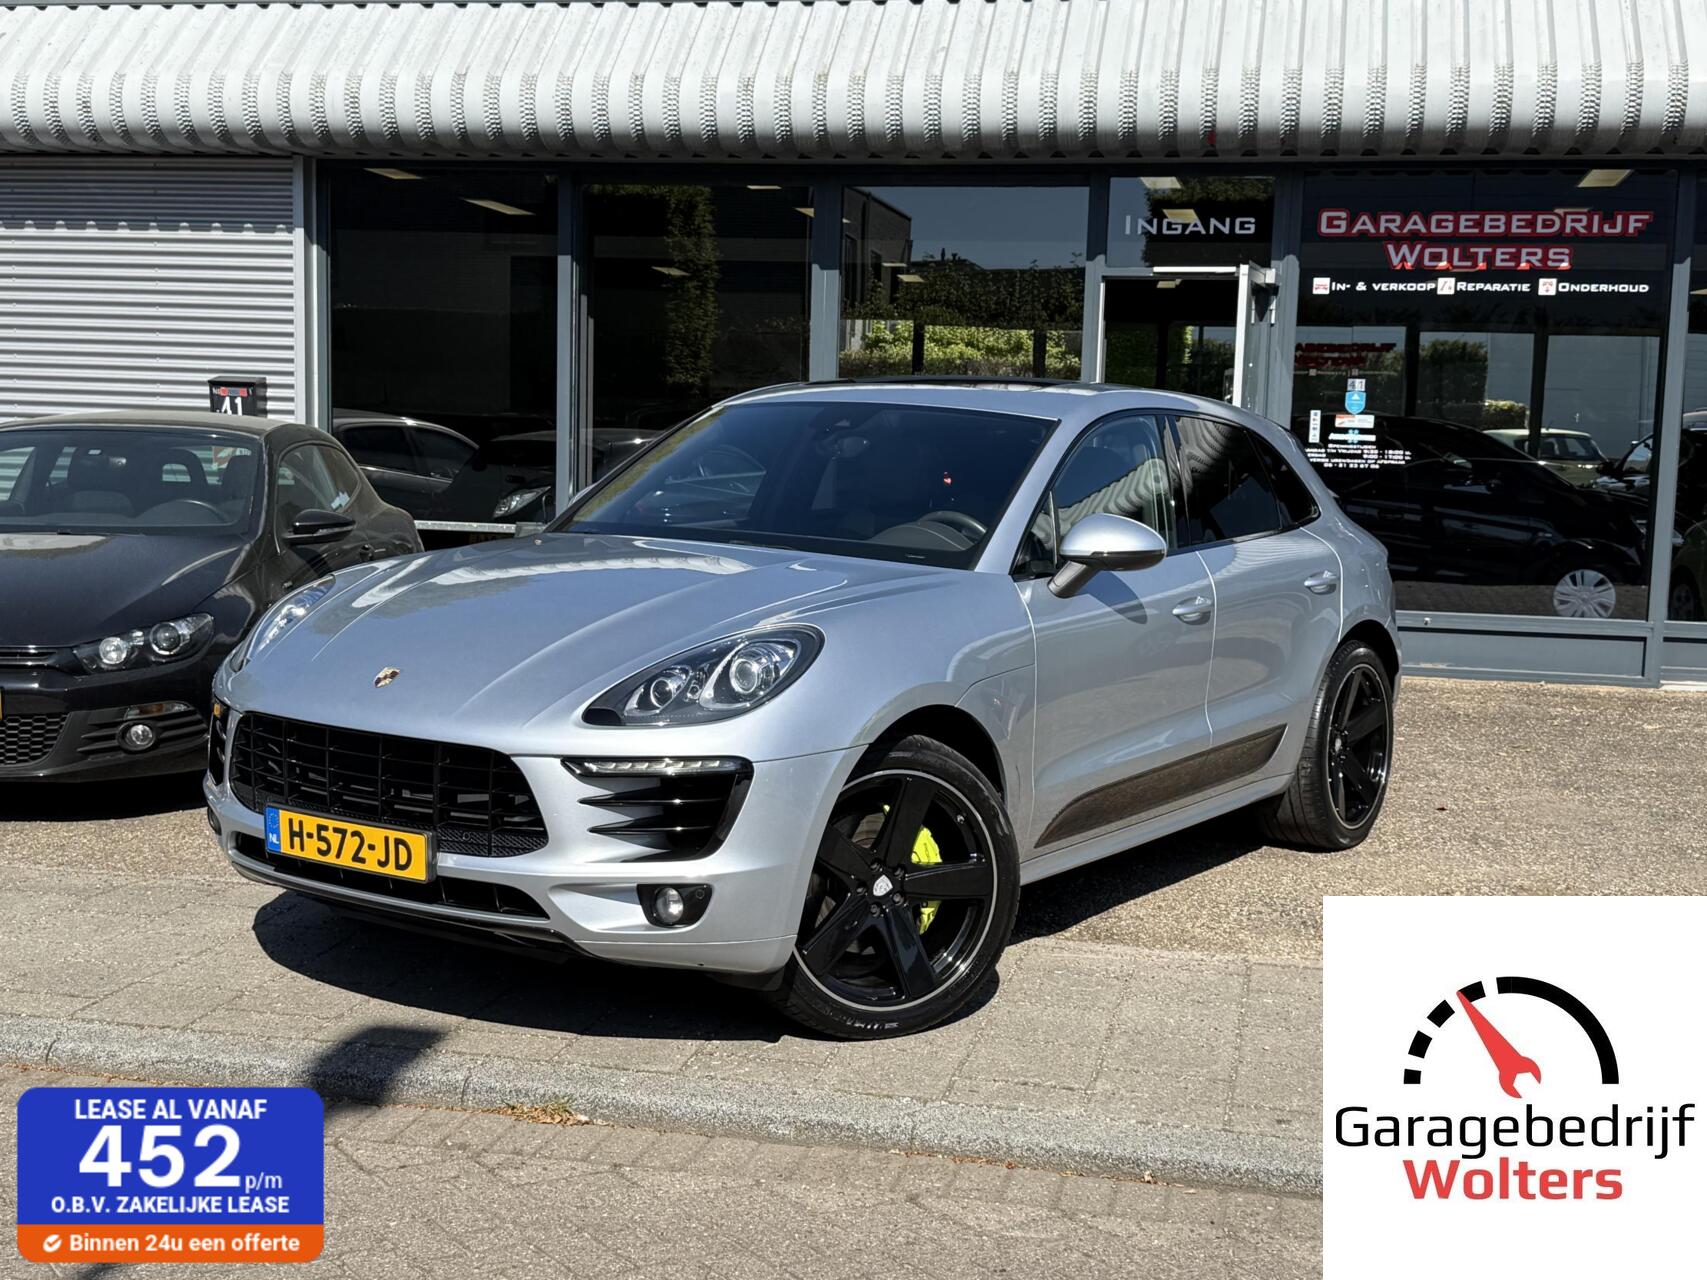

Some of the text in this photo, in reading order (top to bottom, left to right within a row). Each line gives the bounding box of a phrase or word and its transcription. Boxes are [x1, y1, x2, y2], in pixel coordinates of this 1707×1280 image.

[1319, 210, 1651, 235] GARAGEBEDRIJF
[1386, 243, 1572, 268] WOLTERS
[1355, 281, 1367, 291] &
[1456, 282, 1531, 292] REPARATIE
[1558, 283, 1650, 292] ONDERHOUD
[268, 833, 280, 844] NL
[288, 818, 413, 871] H-572-JD
